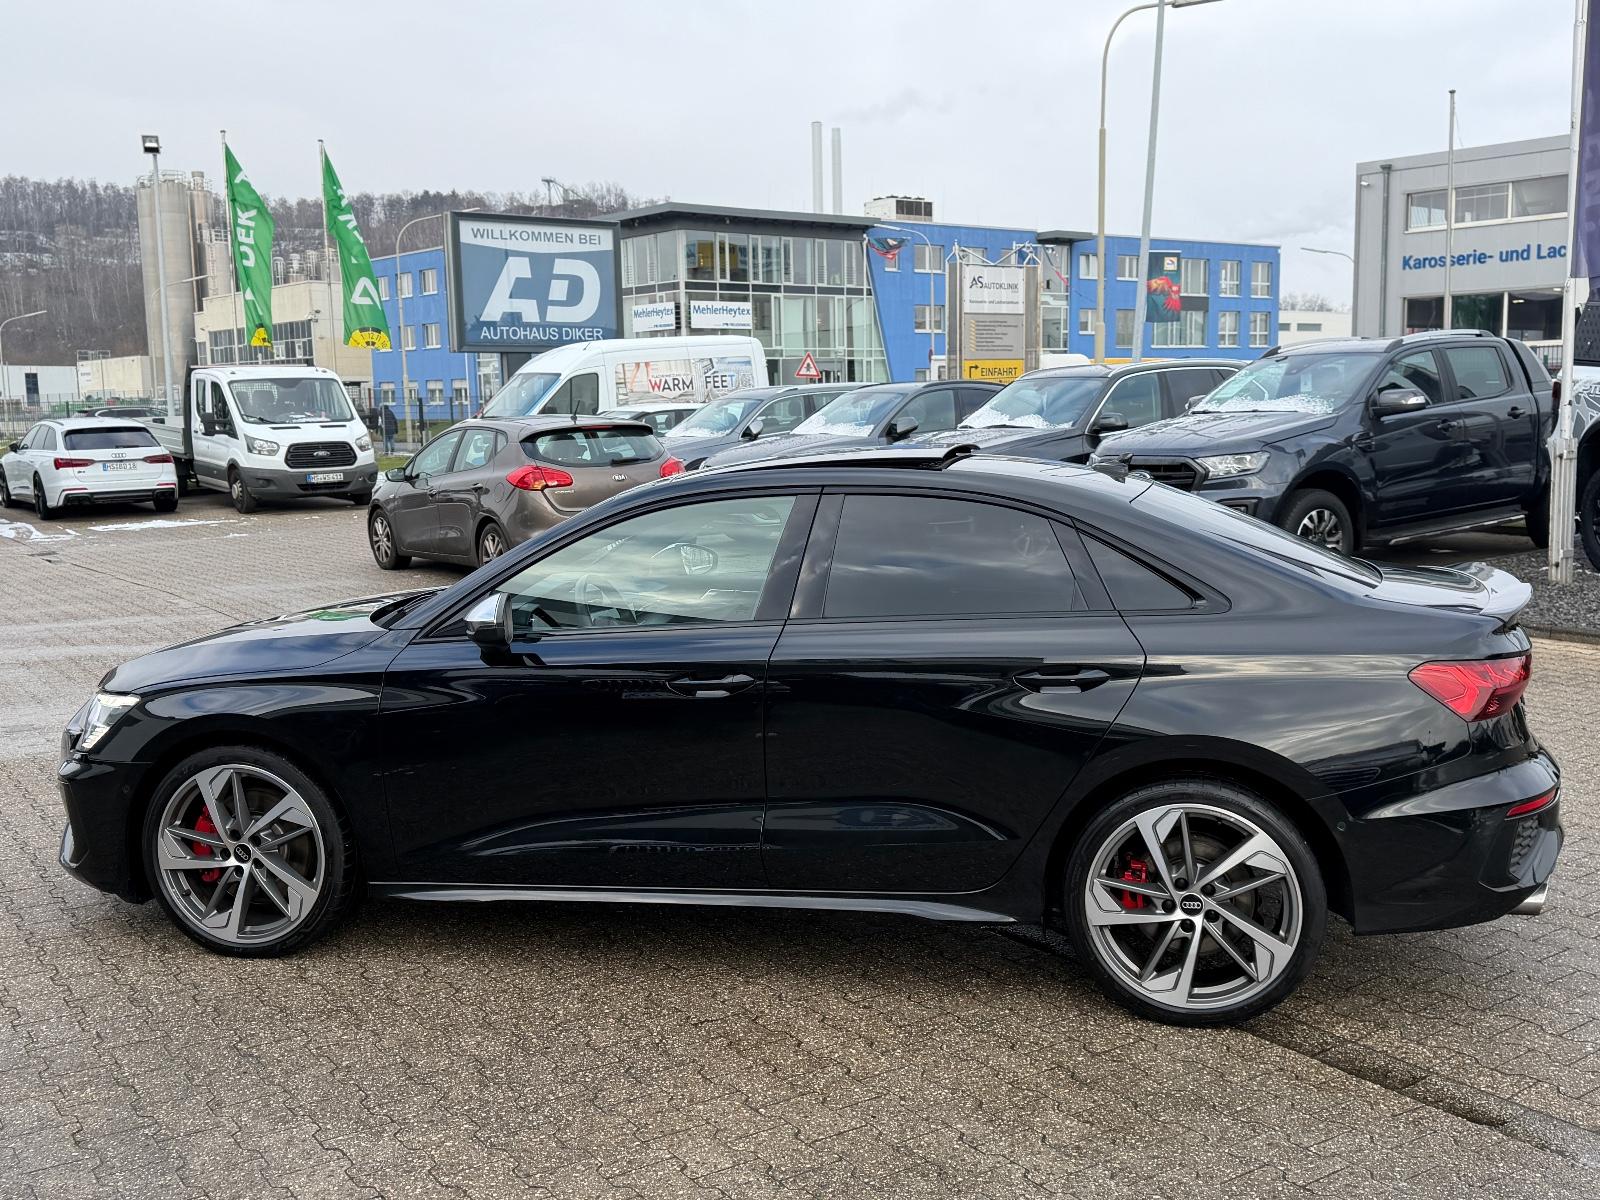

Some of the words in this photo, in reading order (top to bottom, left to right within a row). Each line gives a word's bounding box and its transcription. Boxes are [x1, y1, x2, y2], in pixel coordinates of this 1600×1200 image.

[471, 227, 574, 244] WILLKOMMEN
[578, 234, 601, 245] BEI
[1402, 249, 1494, 271] Karosserie-
[1499, 244, 1531, 263] und
[1536, 243, 1567, 260] Lac
[479, 256, 601, 323] AD
[633, 306, 674, 319] MehlerHeytex
[692, 304, 751, 318] MehlerHeytex
[480, 326, 559, 340] AUTOHAUS
[562, 328, 603, 341] DIKER
[980, 367, 1018, 377] EINFAHRT
[648, 377, 694, 393] WARM
[704, 374, 736, 390] FEET
